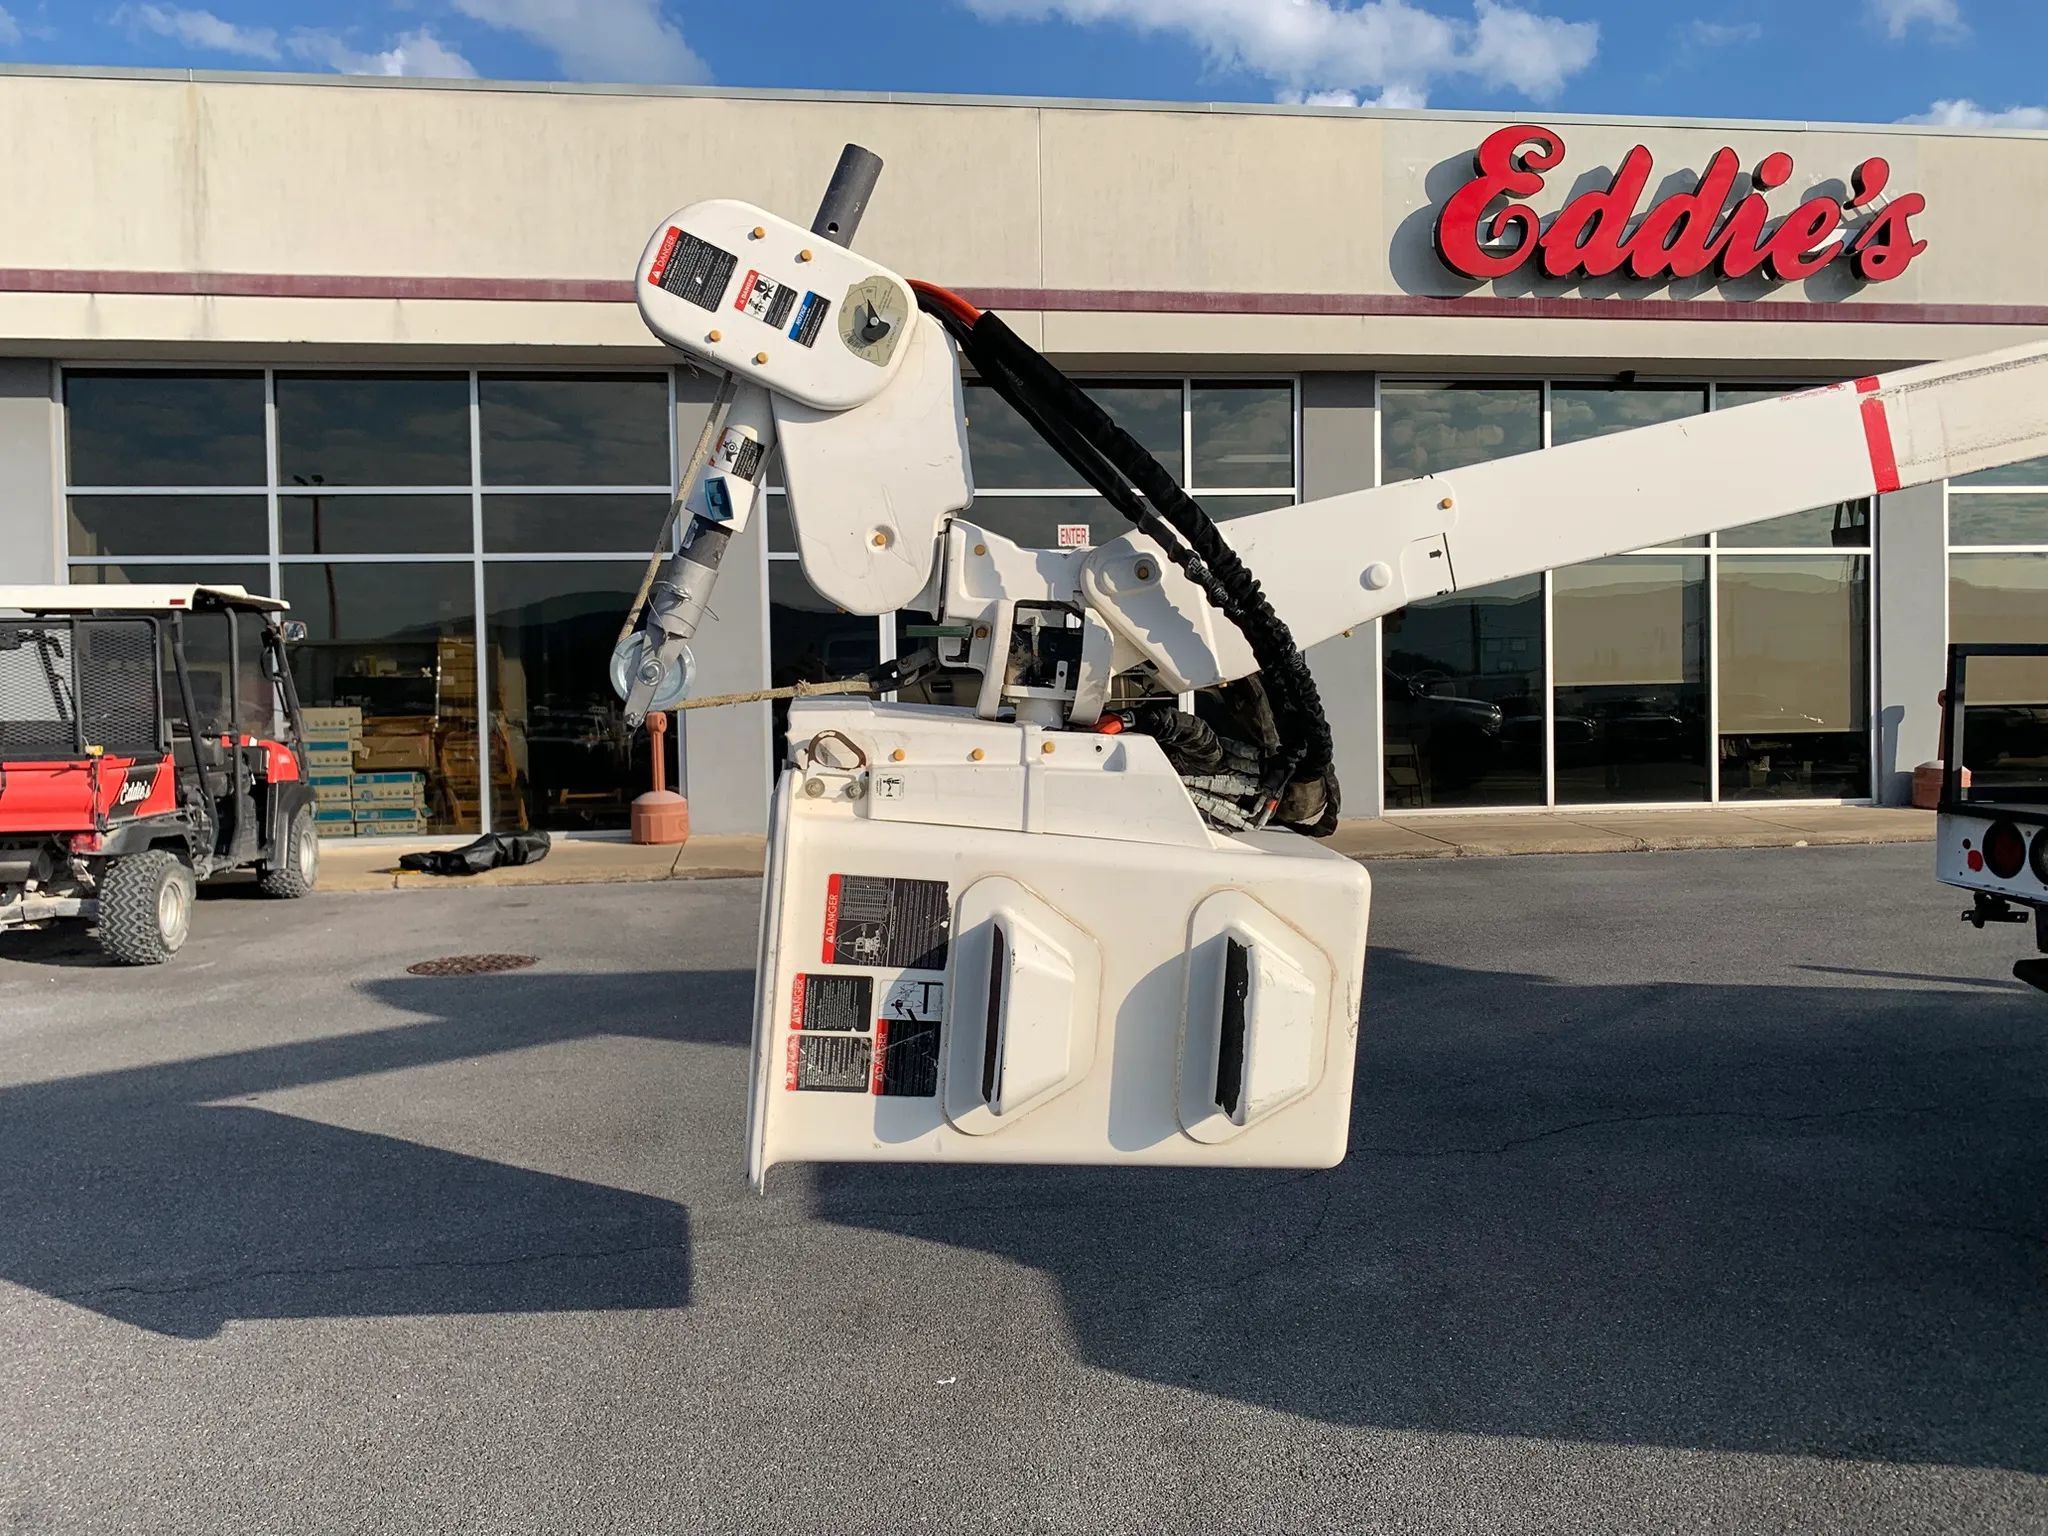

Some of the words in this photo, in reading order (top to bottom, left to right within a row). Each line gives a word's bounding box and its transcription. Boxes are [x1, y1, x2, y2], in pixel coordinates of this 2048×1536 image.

[1436, 125, 1926, 281] Eddie's
[657, 235, 676, 267] DANGER
[741, 275, 755, 299] DANGER
[796, 304, 808, 326] NOTICE
[1061, 527, 1086, 544] ENTER
[119, 779, 151, 805] Eddie's
[826, 894, 838, 935] DANGER
[792, 980, 804, 1017] DANGER
